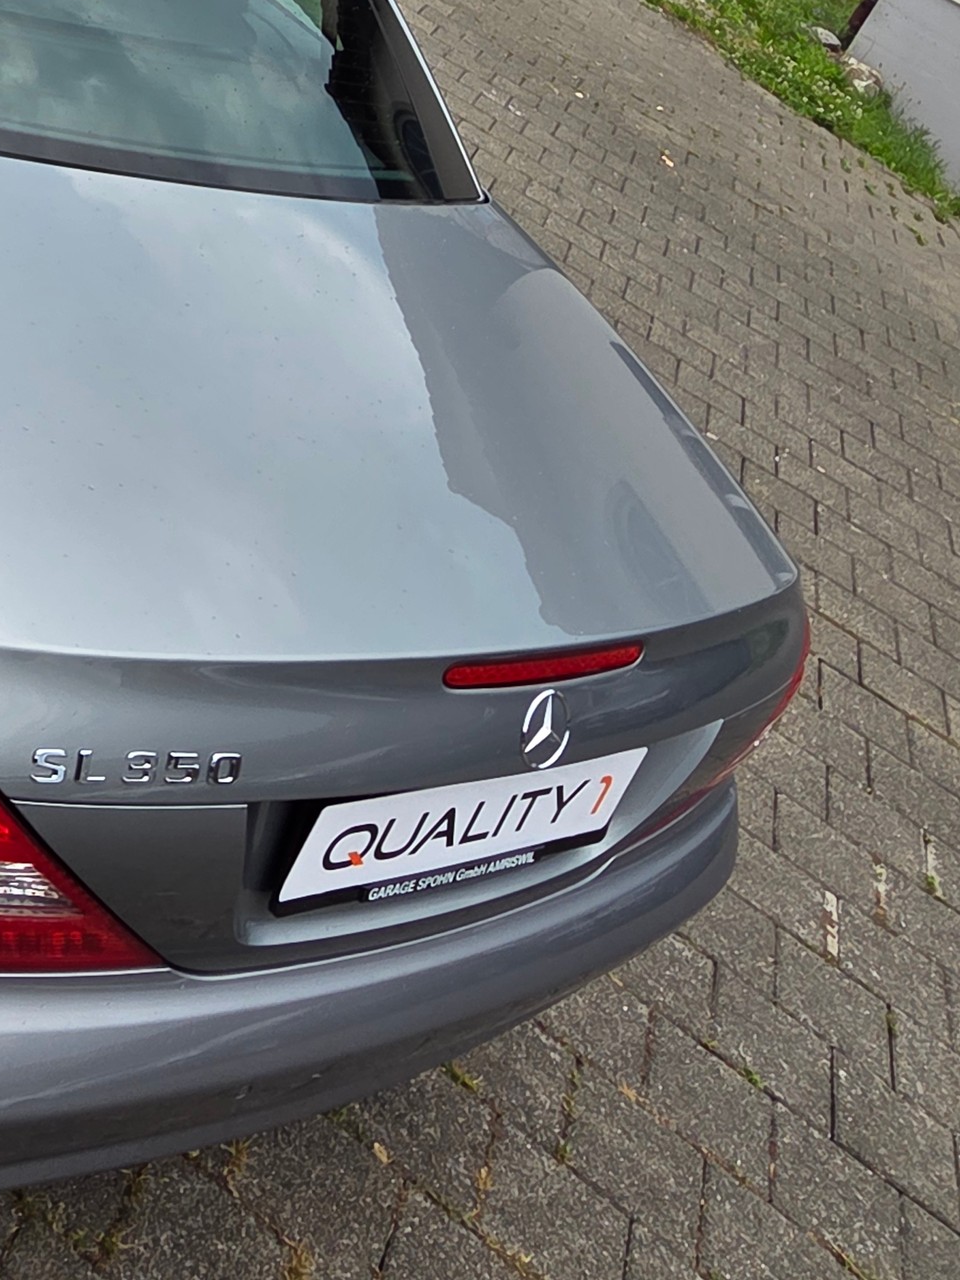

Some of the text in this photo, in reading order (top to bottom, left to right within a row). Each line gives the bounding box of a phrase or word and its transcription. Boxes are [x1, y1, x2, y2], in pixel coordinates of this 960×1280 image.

[31, 749, 242, 785] SL 350
[368, 851, 535, 901] GARAGE SPOHN GmbH AMRISWIL
